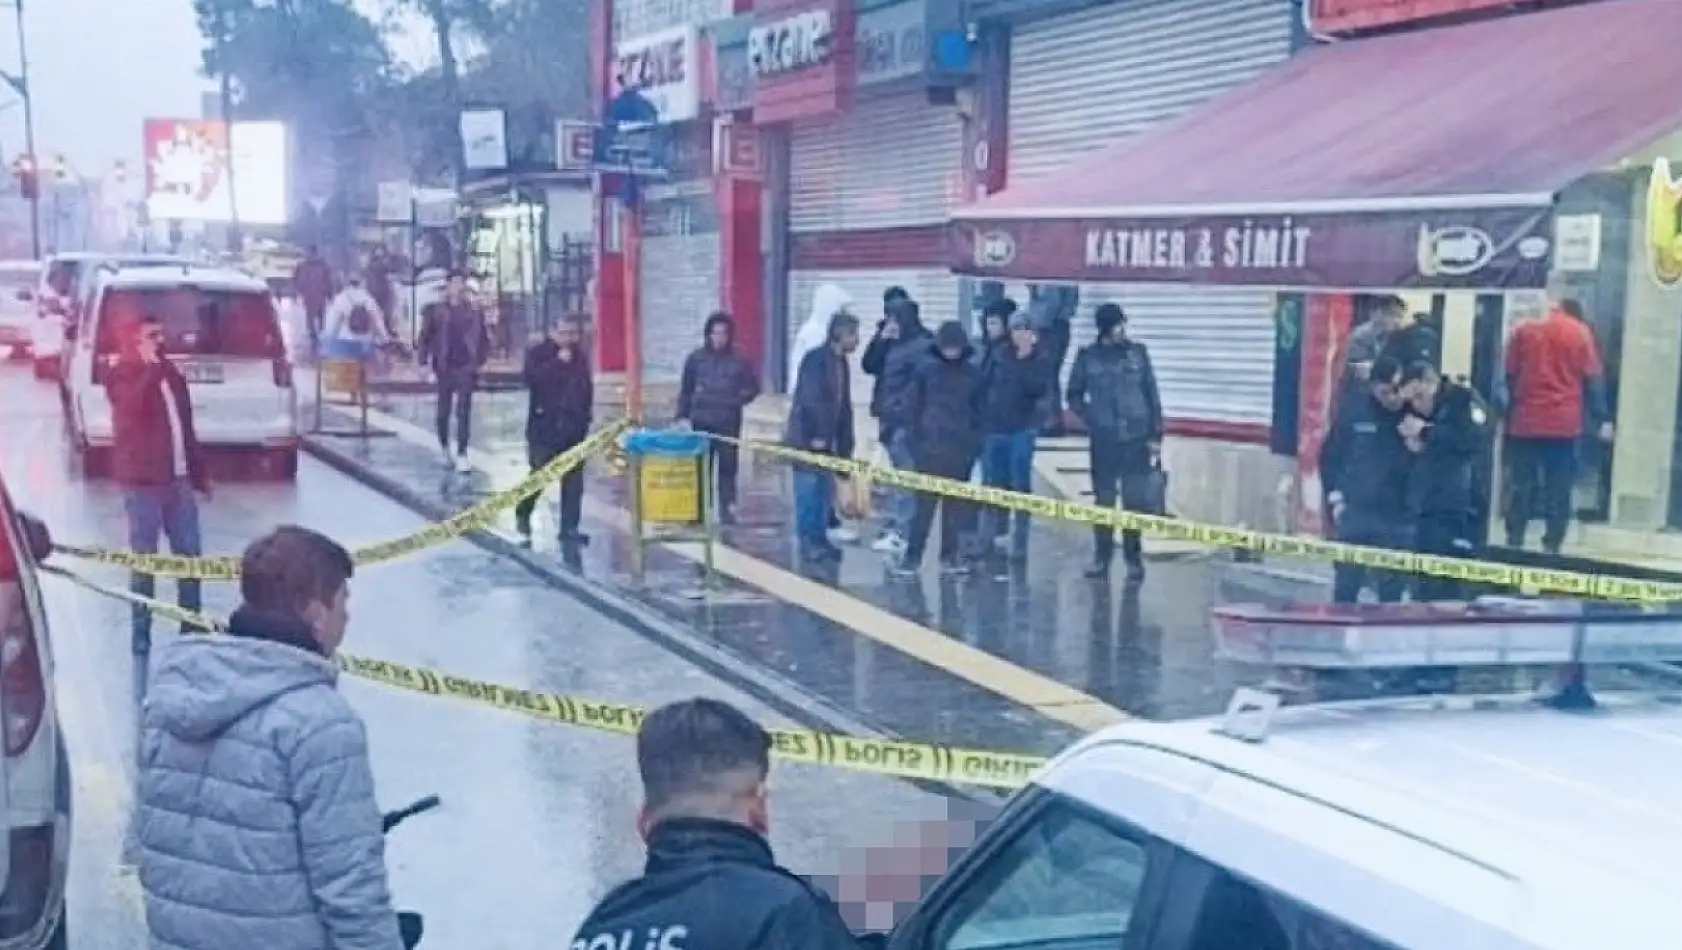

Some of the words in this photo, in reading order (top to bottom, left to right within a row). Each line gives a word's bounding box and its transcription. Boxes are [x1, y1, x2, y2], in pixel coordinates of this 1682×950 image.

[1086, 227, 1186, 268] KATMER
[1196, 227, 1215, 268] &
[1223, 216, 1311, 268] SİMİT
